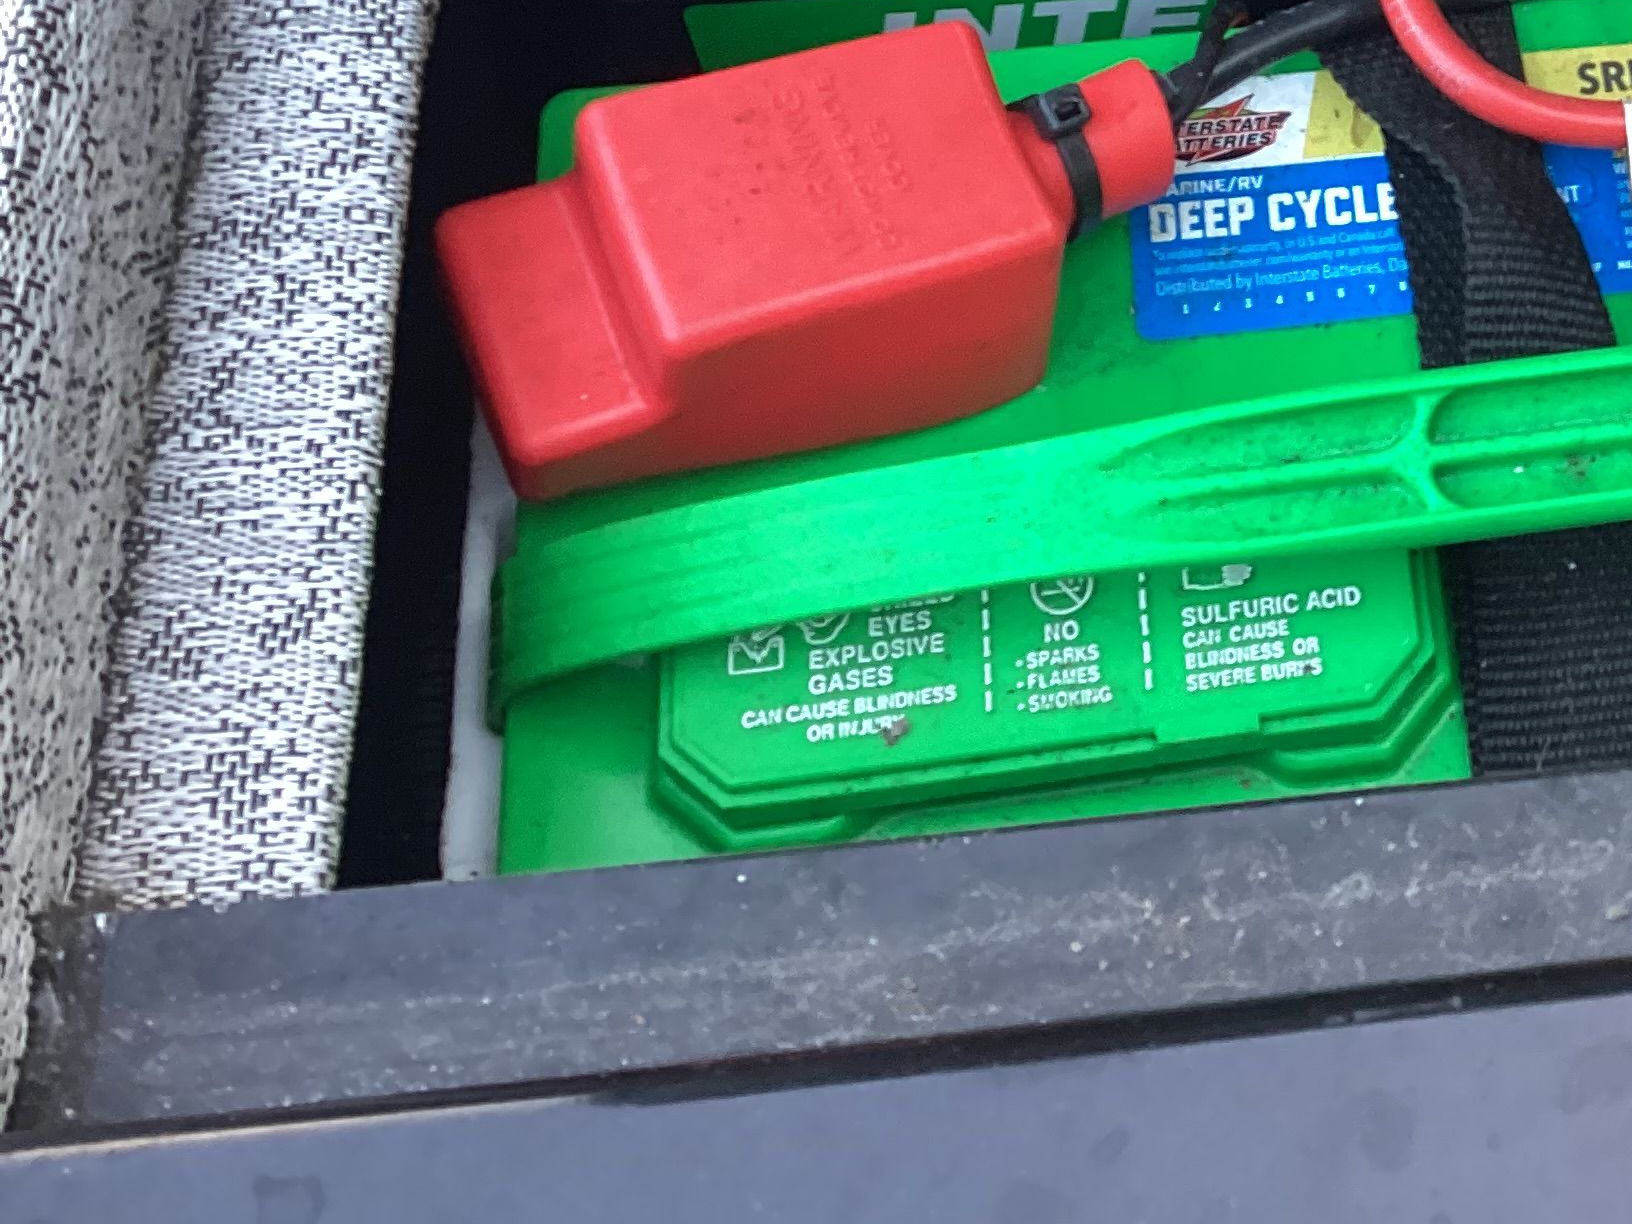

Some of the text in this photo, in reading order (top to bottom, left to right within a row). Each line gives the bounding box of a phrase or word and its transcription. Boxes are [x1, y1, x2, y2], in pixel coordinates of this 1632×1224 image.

[1165, 174, 1264, 197] ARINE/RV
[1149, 182, 1400, 243] DEEP CYCLE
[1235, 273, 1253, 292] by
[1181, 585, 1362, 628] SULFURIC ACID
[867, 609, 933, 638] EYES
[1043, 619, 1080, 643] NO
[1182, 618, 1290, 649] CAN CAUSE
[808, 632, 946, 670] EXPLOSIVE
[1026, 643, 1101, 670] SPARKS
[1184, 635, 1321, 670] BLINDNESS OR
[807, 665, 895, 696] GASES
[1027, 664, 1101, 690] FLAMES
[1186, 665, 1257, 693] SEVERE
[741, 683, 958, 729] CAN CAUSE BLINDNESS
[1027, 684, 1113, 713] SMOKING
[806, 723, 835, 743] OR
